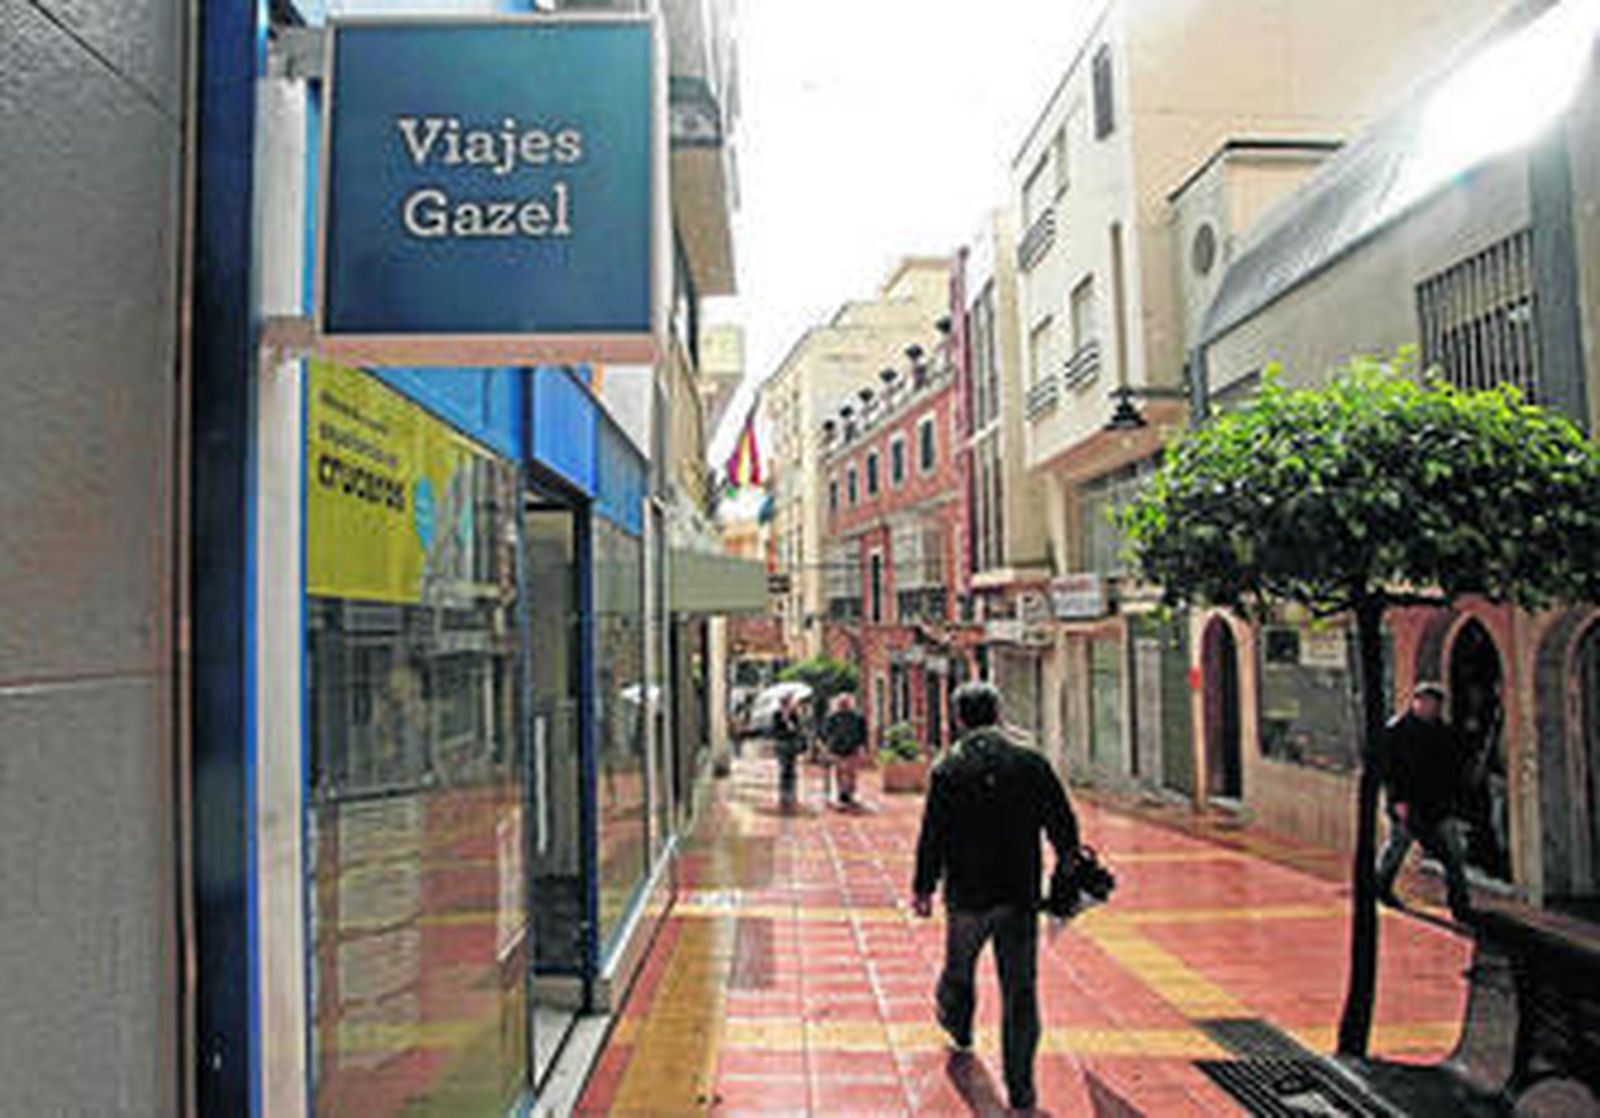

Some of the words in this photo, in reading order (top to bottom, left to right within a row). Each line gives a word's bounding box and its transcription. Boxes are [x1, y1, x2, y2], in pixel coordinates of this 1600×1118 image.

[398, 117, 583, 174] Viajes
[403, 182, 572, 237] Gazel
[318, 452, 406, 513] cruceros
